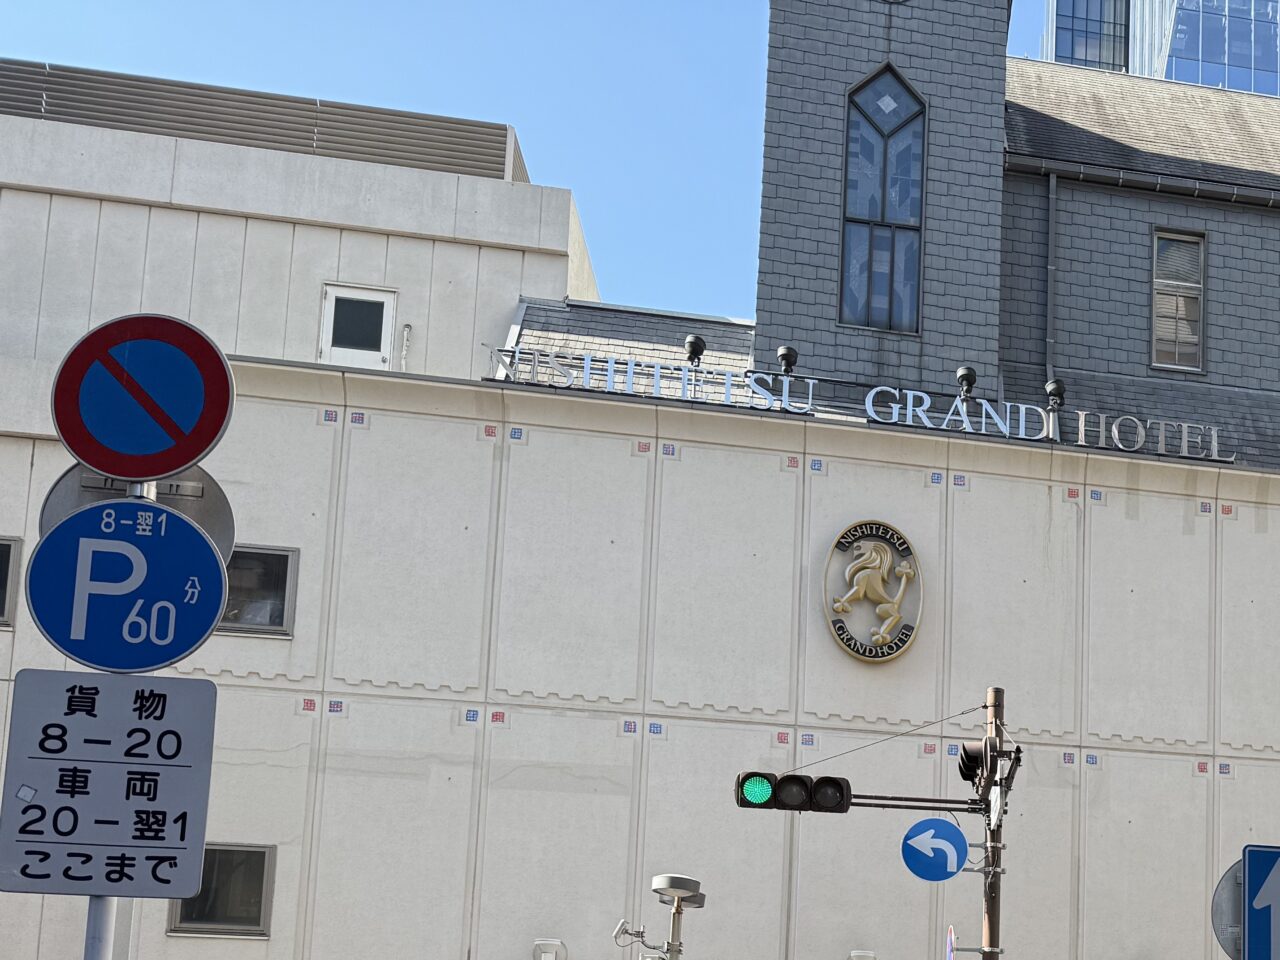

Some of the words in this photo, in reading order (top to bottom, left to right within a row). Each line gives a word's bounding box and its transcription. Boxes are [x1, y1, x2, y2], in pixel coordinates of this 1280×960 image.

[481, 342, 819, 414] NISHITETSU
[865, 385, 1050, 441] GRAND
[1074, 409, 1237, 462] HOTEL
[839, 523, 908, 552] NISHITETSU
[70, 537, 148, 640] P
[122, 598, 176, 646] 60
[183, 576, 201, 604] 分
[835, 622, 877, 657] GRAND
[878, 627, 913, 657] HOTEL
[19, 850, 178, 885] ここまで
